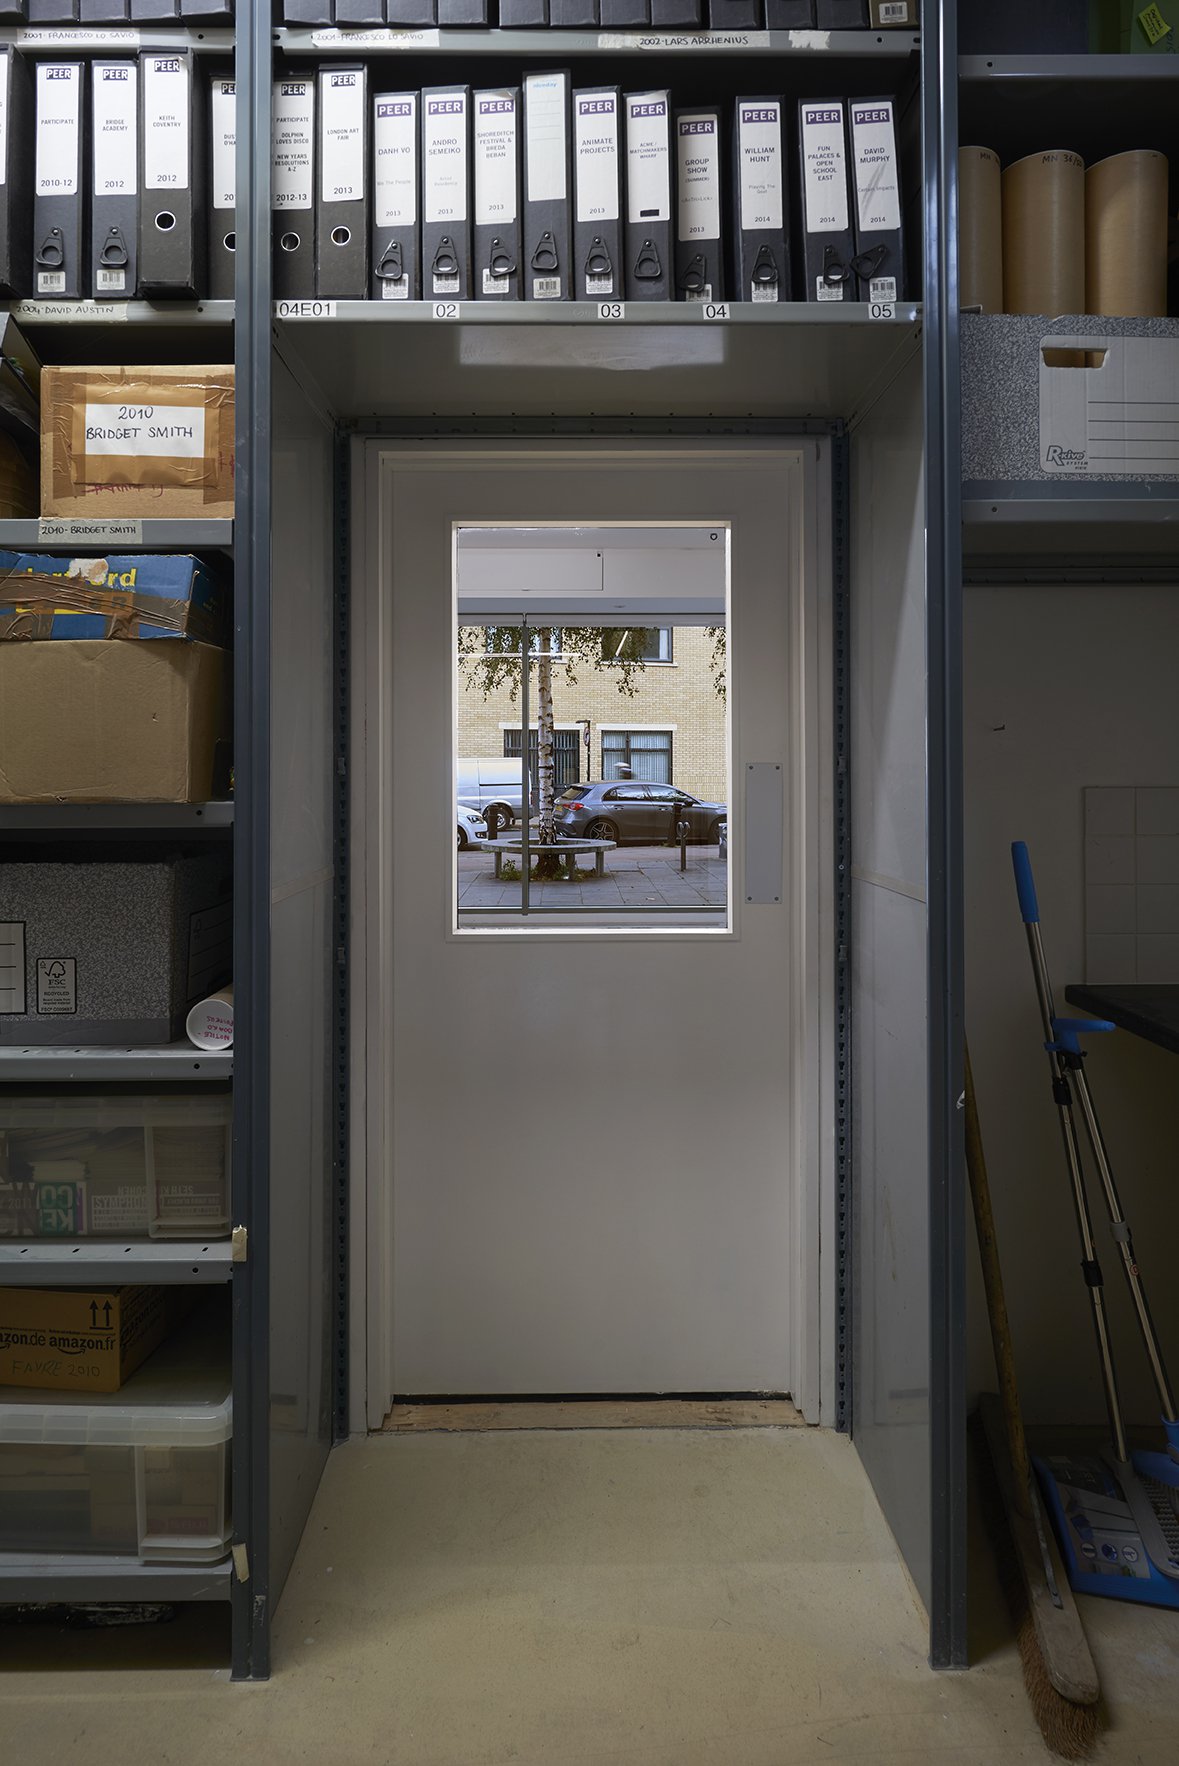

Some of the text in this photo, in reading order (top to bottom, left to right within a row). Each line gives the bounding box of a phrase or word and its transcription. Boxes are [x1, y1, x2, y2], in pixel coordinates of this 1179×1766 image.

[691, 36, 748, 45] ARRHENIUS
[154, 60, 179, 72] PEER
[46, 68, 71, 79] PEER
[103, 69, 128, 80] PEER
[331, 75, 356, 86] PEER
[222, 84, 236, 94] PE
[281, 84, 306, 96] PEER
[378, 104, 410, 116] PEER
[430, 102, 462, 113] PEER
[481, 102, 512, 112] PEER
[580, 102, 613, 113] PEER
[632, 104, 664, 116] PEER
[744, 111, 776, 120] PEER
[808, 112, 839, 122] PEER
[856, 112, 888, 122] PEER
[682, 122, 712, 133] PEER
[477, 130, 514, 138] SHOREDITCH
[582, 138, 613, 146] ANIMATE
[378, 148, 398, 156] DANH
[429, 148, 461, 156] SEMEIKO
[580, 146, 615, 154] PROJECTS
[157, 174, 177, 182] 2012
[75, 306, 114, 314] AUSTIN
[279, 302, 331, 316] 04E01
[436, 304, 456, 318] 02
[601, 304, 621, 318] 03
[706, 304, 726, 318] 04
[871, 304, 892, 318] 05
[118, 406, 154, 420] 2010
[86, 426, 193, 440] BRIDGET SMITH
[70, 526, 107, 534] BRIDGET
[110, 526, 136, 534] SMITH
[49, 1337, 116, 1350] amazon.fr
